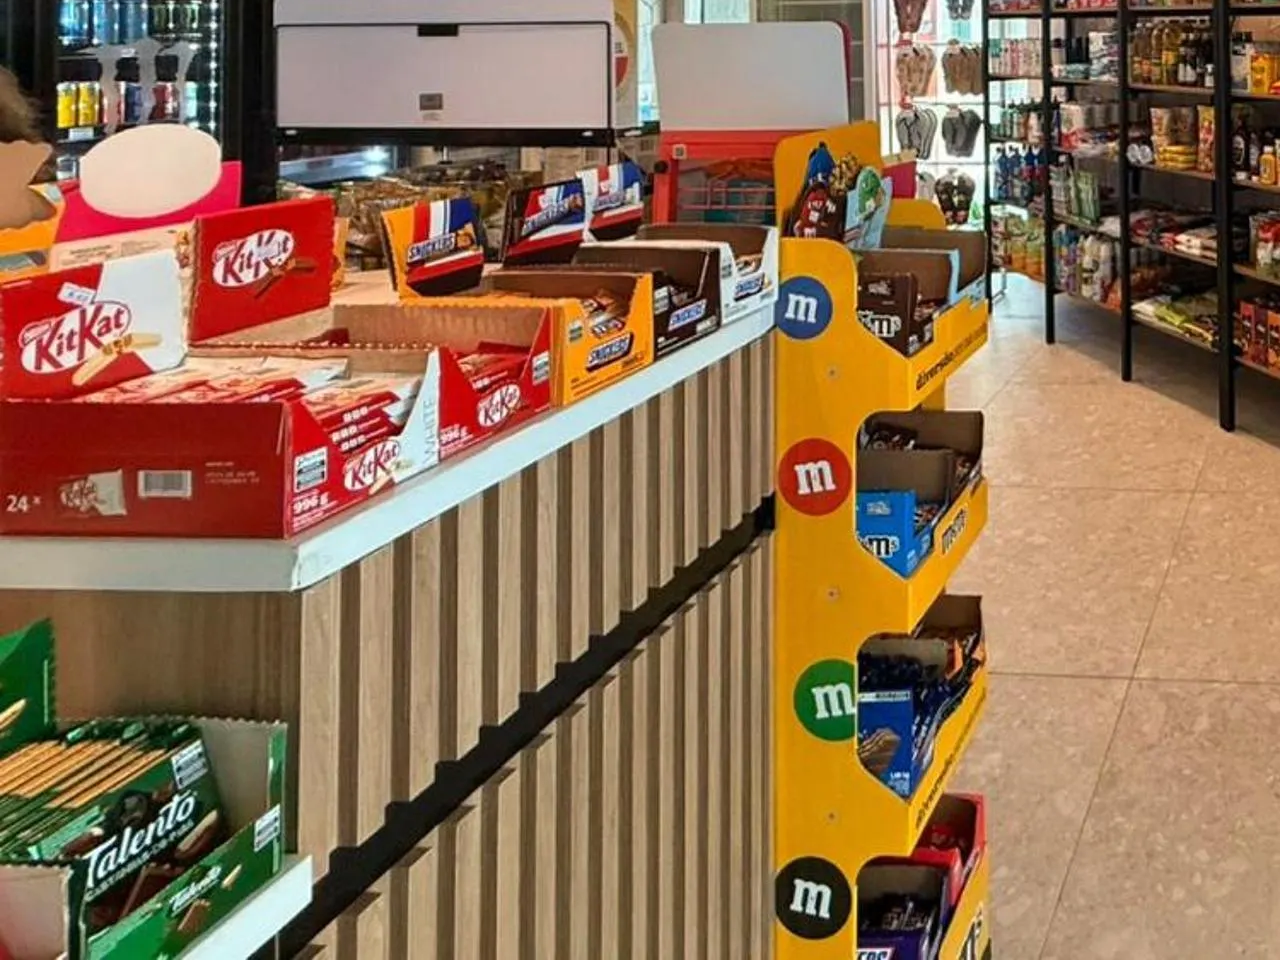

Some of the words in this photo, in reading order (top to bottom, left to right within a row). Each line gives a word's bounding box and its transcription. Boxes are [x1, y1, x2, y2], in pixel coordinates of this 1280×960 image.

[222, 230, 291, 284] KitKt
[784, 293, 818, 324] m
[34, 303, 126, 371] KitKat
[422, 397, 436, 464] WHITE
[350, 442, 397, 488] KitKat
[794, 460, 837, 496] m
[6, 495, 30, 513] 24
[811, 682, 857, 719] m
[82, 790, 198, 889] Talento
[789, 878, 832, 920] m
